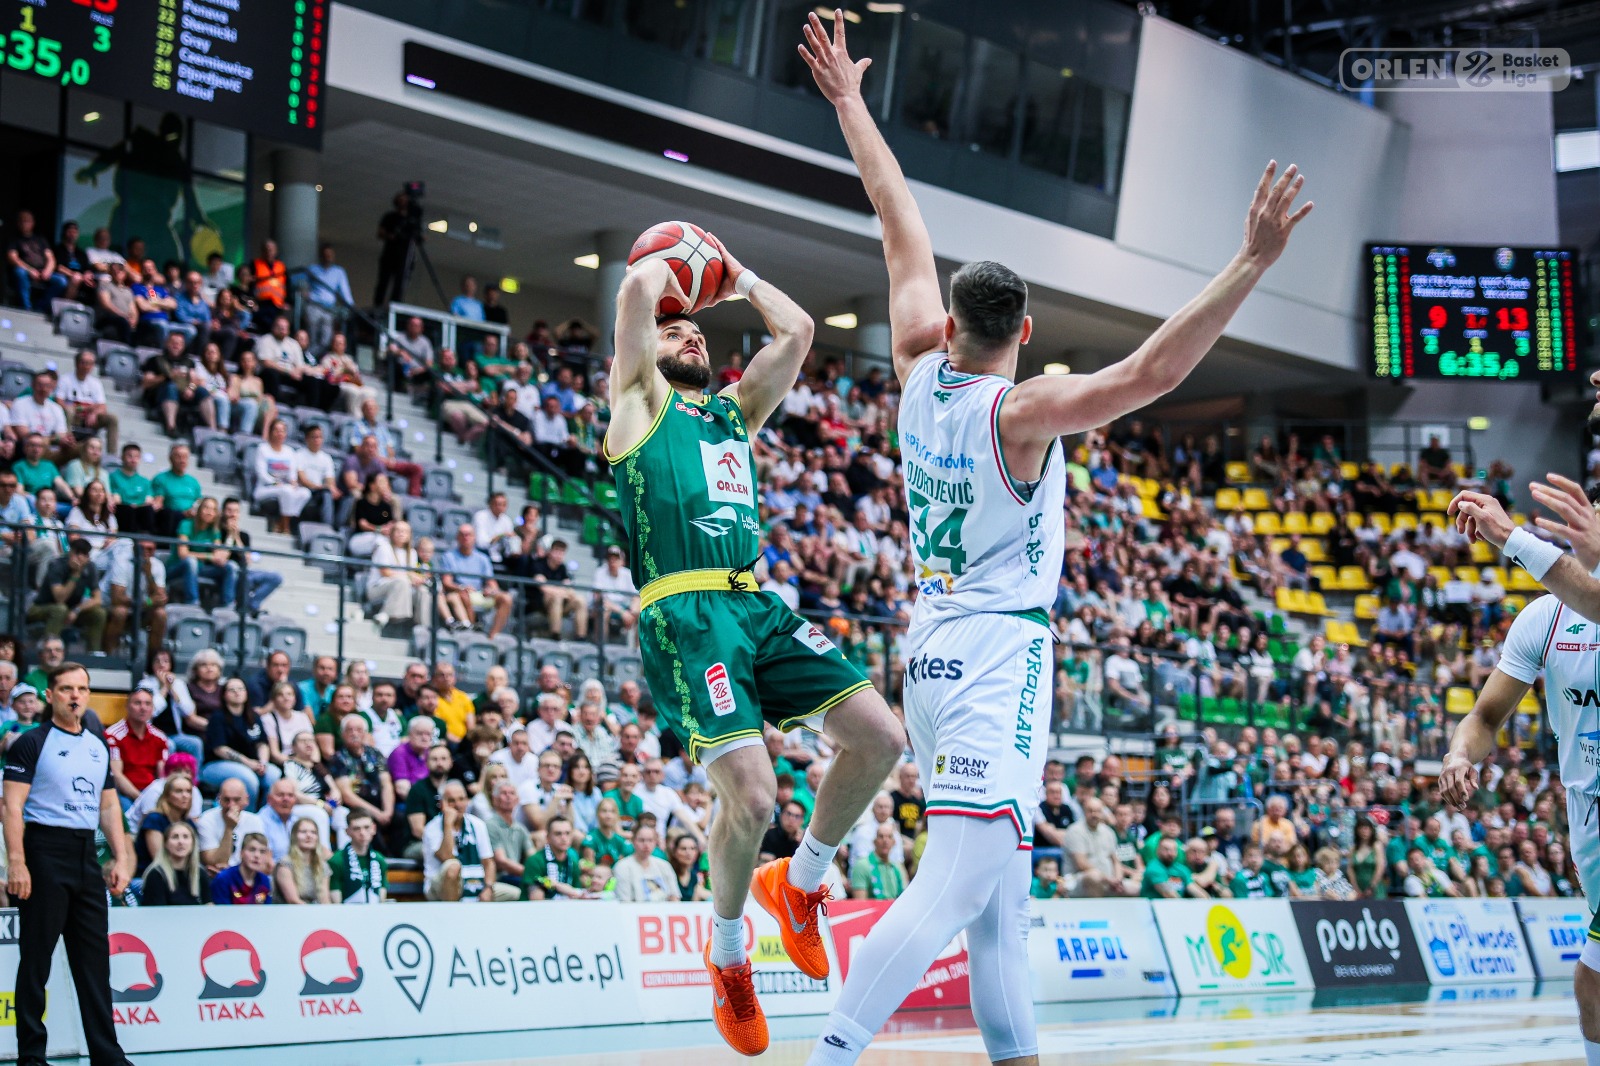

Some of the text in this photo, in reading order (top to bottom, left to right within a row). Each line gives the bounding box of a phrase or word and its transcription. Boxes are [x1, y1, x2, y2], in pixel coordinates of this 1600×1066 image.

[20, 5, 37, 33] 1
[92, 25, 111, 52] 3
[1428, 305, 1448, 329] 9
[1495, 307, 1529, 330] 13
[717, 480, 748, 495] ORLEN
[1566, 623, 1586, 635] 4F
[816, 639, 830, 649] ORL
[1557, 643, 1579, 651] ORLEN
[1014, 637, 1044, 759] WROCŁAW
[949, 764, 985, 779] ŚLĄSK
[950, 755, 990, 770] DOLNY
[1056, 936, 1128, 962] ARPOL
[449, 944, 624, 995] Alejade.pl
[112, 1005, 160, 1026] AKA
[198, 1002, 265, 1023] ITAKA
[299, 998, 362, 1018] ITAKA
[830, 1034, 848, 1046] NIKE
